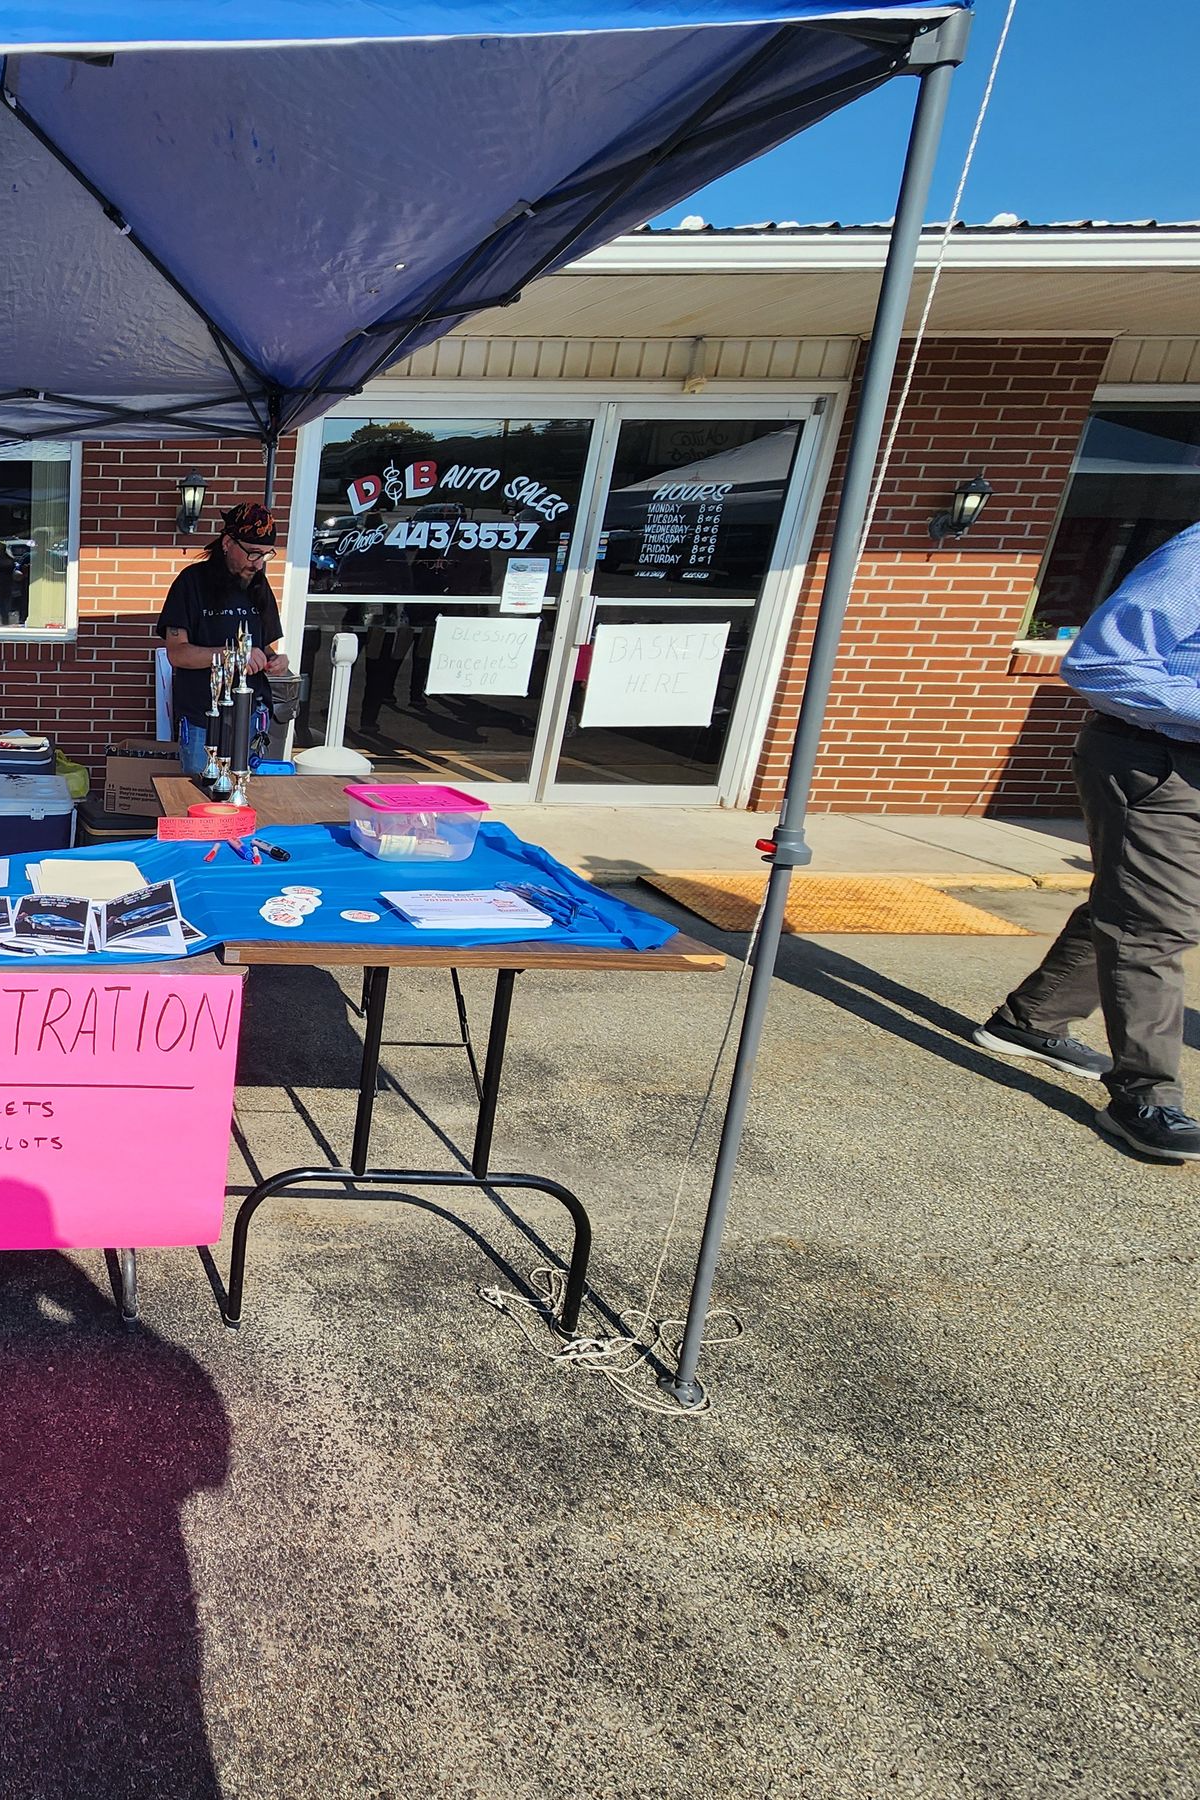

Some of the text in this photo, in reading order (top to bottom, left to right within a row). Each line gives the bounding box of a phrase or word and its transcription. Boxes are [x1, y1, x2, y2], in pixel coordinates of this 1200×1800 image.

[347, 459, 569, 521] D & B AUTO SALES
[652, 482, 733, 501] HOURS
[648, 504, 682, 513] MONDAY
[646, 514, 686, 524] TUESDAY
[384, 517, 540, 557] 443/3537
[644, 525, 690, 534] WEDNESDAY
[641, 544, 673, 553] FRIDAY
[643, 535, 687, 544] THURSDAY
[638, 554, 682, 564] SATURDAY
[452, 627, 528, 660] Blessing
[609, 633, 724, 663] BASKETS
[437, 653, 518, 671] Bracelets
[625, 672, 688, 694] HERE
